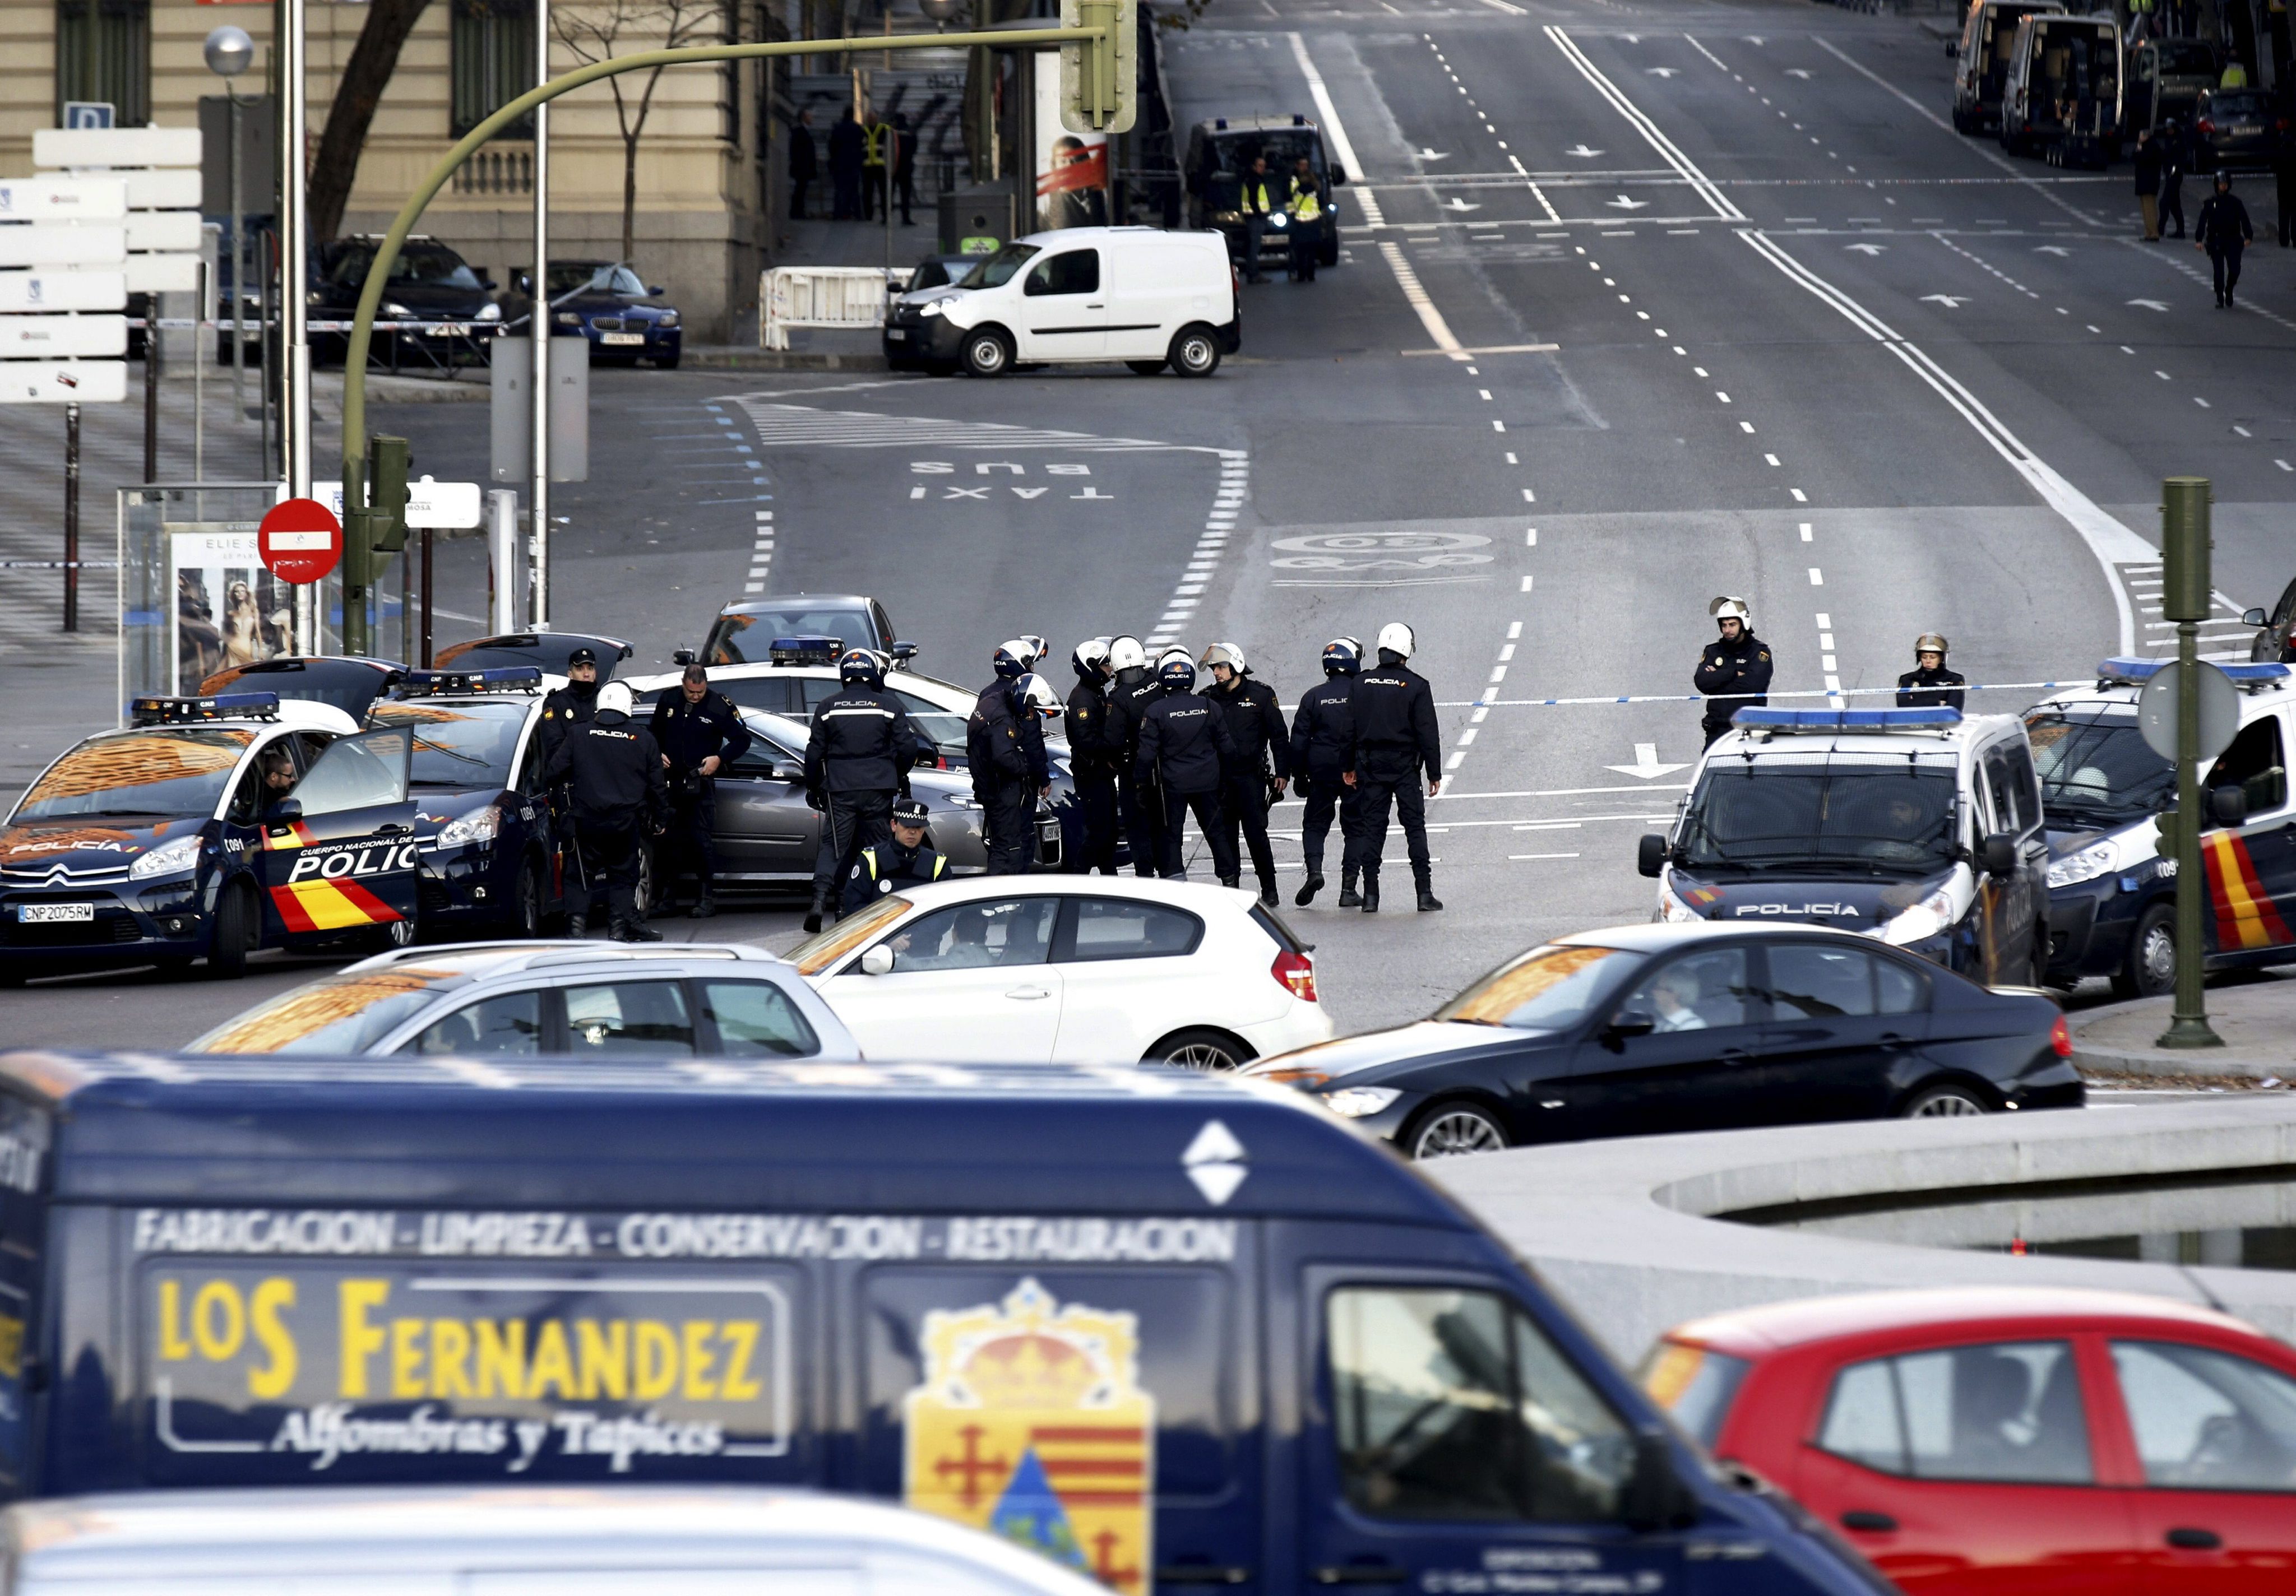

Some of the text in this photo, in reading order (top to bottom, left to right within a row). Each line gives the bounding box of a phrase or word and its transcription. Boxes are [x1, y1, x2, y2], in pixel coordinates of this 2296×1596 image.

[910, 461, 1091, 475] BUS
[910, 486, 1114, 499] TAXI
[206, 539, 240, 549] ELIE
[1132, 681, 1159, 698] POLICIA
[1169, 709, 1206, 718] POLICIA
[589, 730, 629, 739] POLICIA
[9, 839, 122, 855] POLICÍA
[300, 846, 342, 856] CUERPO
[344, 839, 396, 851] NACIONAL
[288, 843, 415, 883] POLIC
[1736, 902, 1859, 916] POLICÍA
[133, 1208, 396, 1254] FABRICACION
[419, 1210, 593, 1257] LIMPIEZA
[945, 1217, 1235, 1261] RESTAURACION
[158, 1276, 763, 1402] LOS FERNANDEZ
[272, 1403, 507, 1470] Alfombras
[506, 1417, 547, 1472] y
